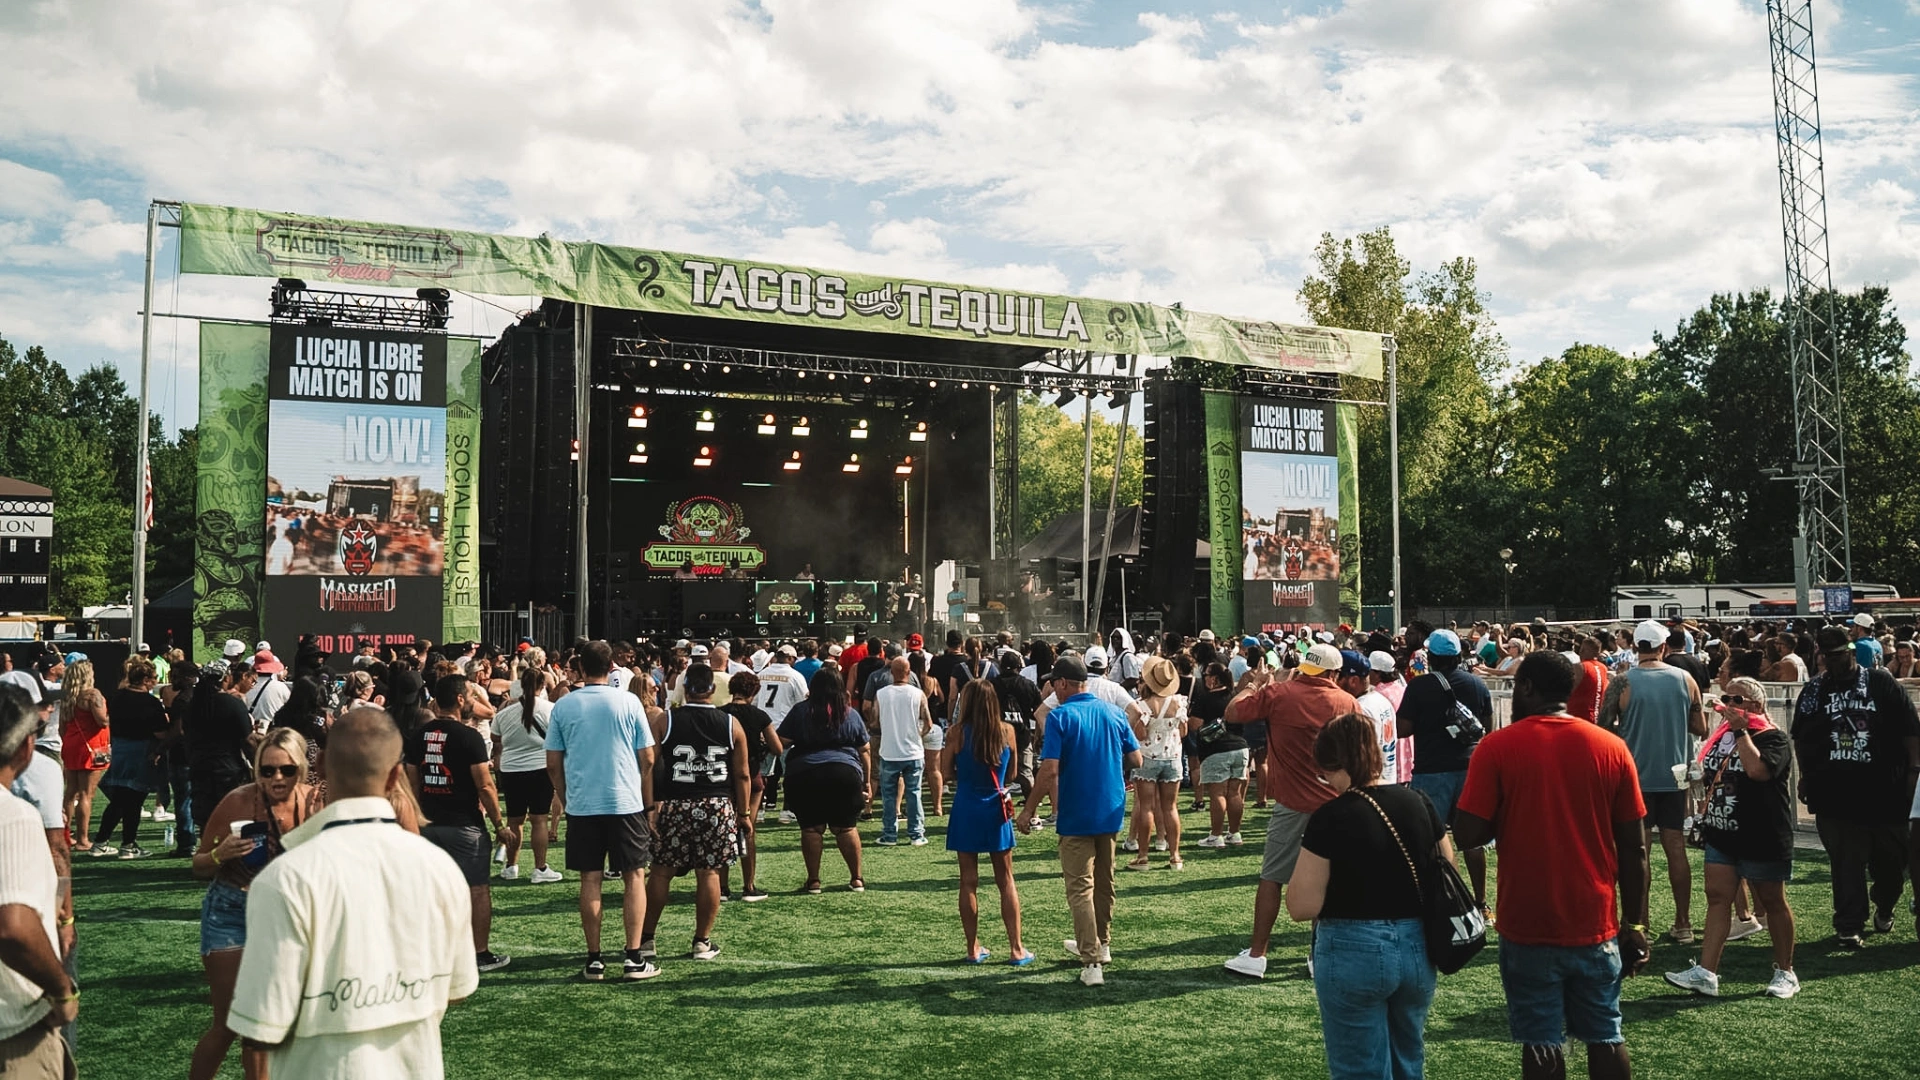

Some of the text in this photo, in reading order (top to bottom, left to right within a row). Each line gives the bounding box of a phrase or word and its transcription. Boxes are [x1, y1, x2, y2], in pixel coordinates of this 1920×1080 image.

[278, 234, 340, 256] TACOS
[362, 241, 442, 265] TEQUILA
[327, 255, 397, 281] Festival
[682, 260, 1091, 341] TACOS and TEQUILA
[295, 336, 423, 373] LUCHA LIBRE
[289, 366, 422, 402] MATCH IS ON
[1254, 404, 1324, 431] LUCHA LIBRE
[345, 415, 432, 464] NOW!
[1251, 426, 1324, 453] MATCH IS ON
[1283, 463, 1330, 499] NOW!
[453, 434, 471, 606] SOCIAL HOUSE
[1218, 468, 1236, 601] SOCIAL HOUSE
[35, 539, 41, 553] E
[653, 550, 692, 563] TACOS
[705, 551, 755, 564] TEQUILA
[319, 577, 397, 612] MASKED
[337, 634, 354, 654] TO
[765, 684, 779, 708] 7
[672, 744, 729, 783] 25
[686, 762, 714, 772] Modelo
[1829, 749, 1872, 763] MUSIC
[1707, 802, 1734, 818] RAP
